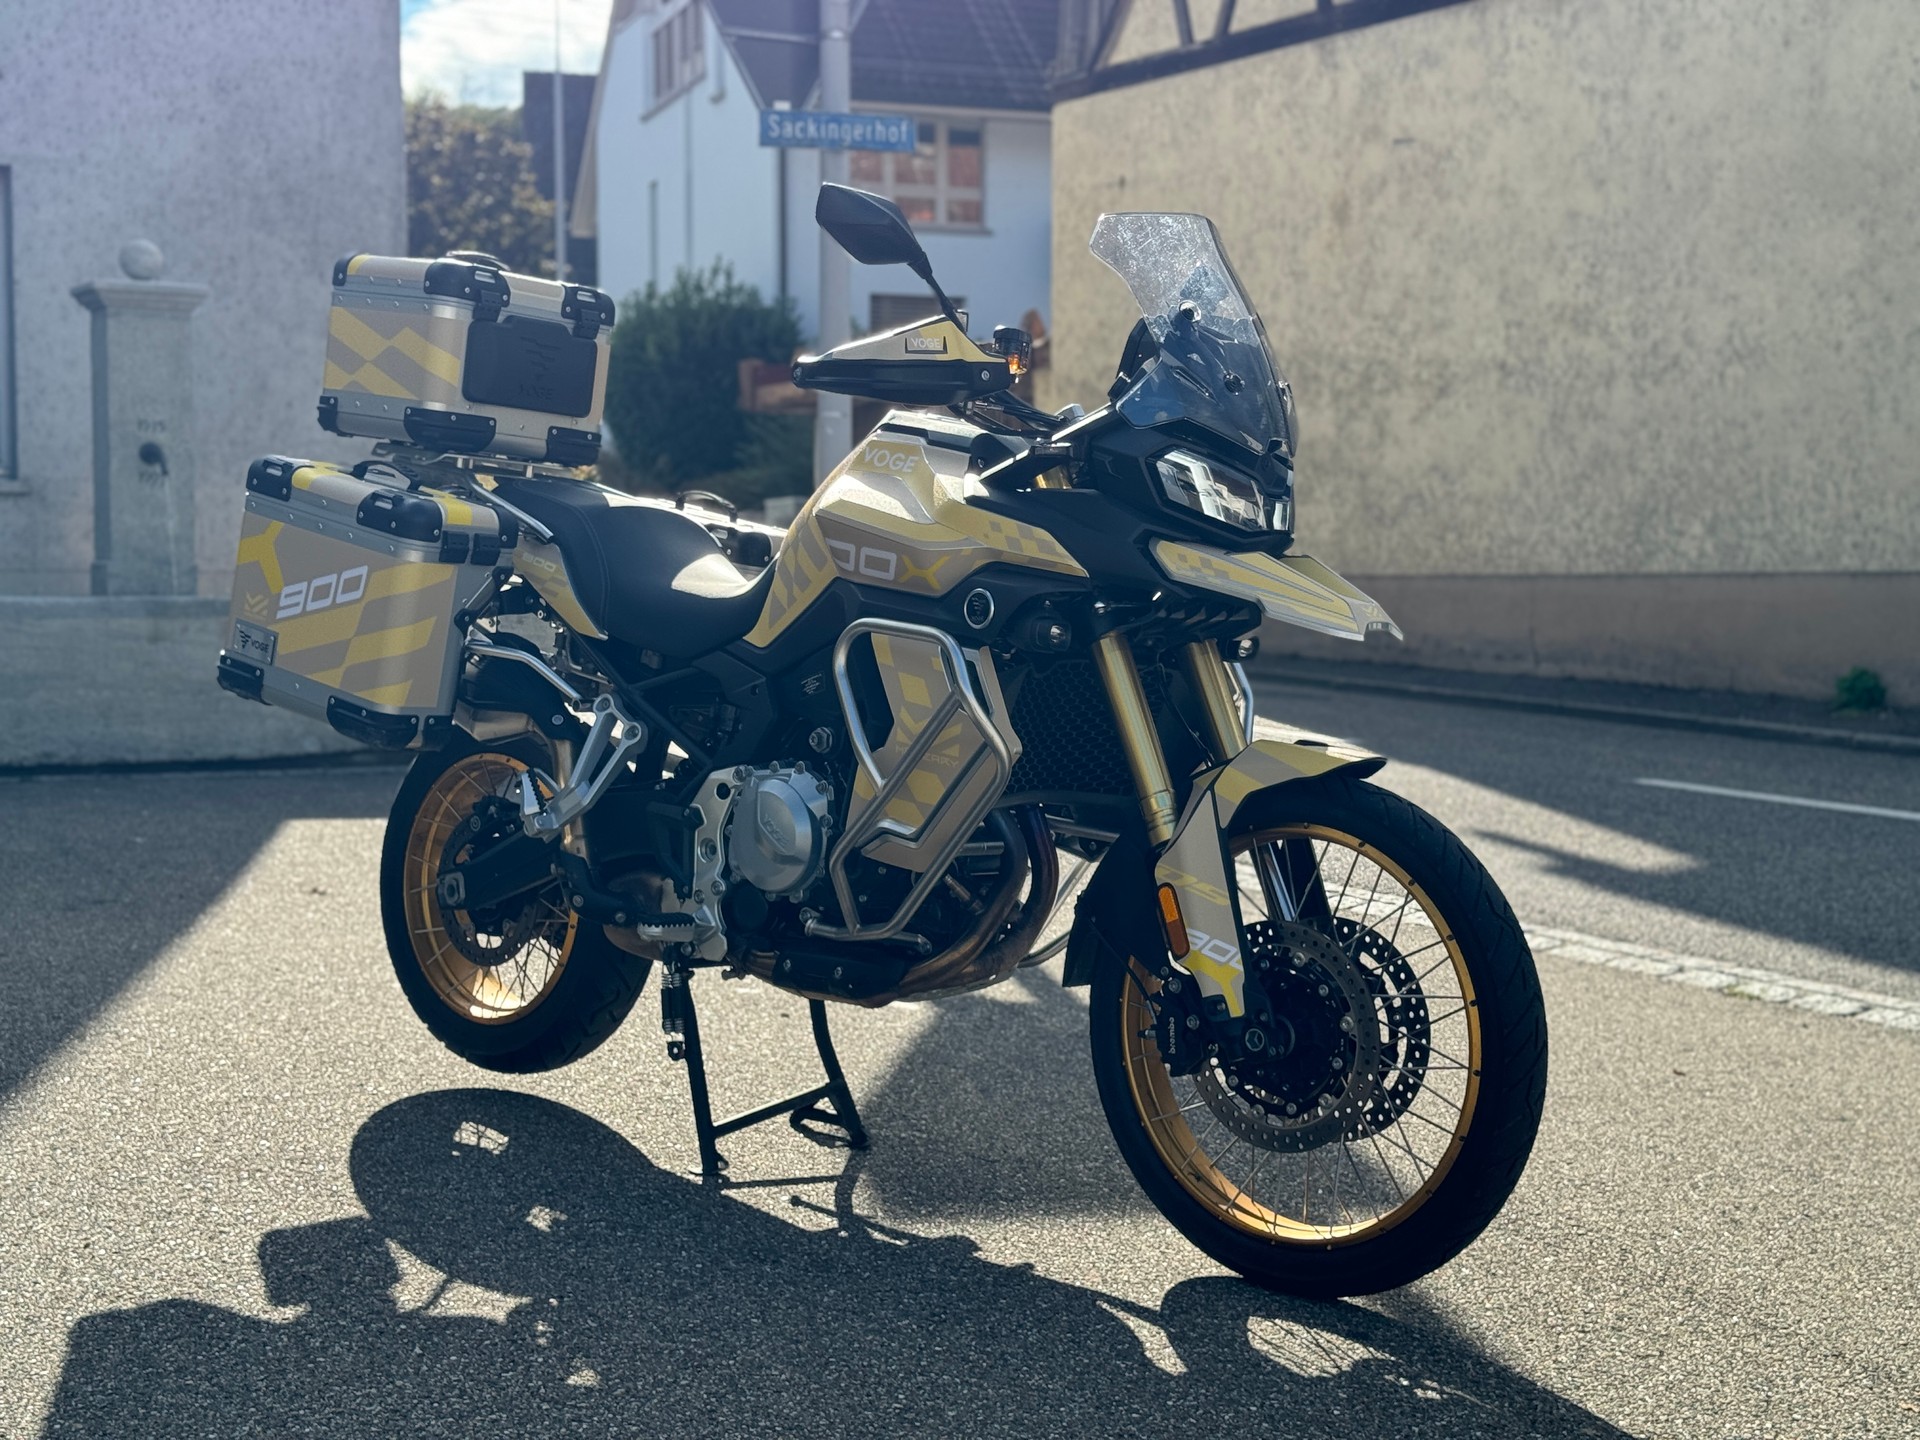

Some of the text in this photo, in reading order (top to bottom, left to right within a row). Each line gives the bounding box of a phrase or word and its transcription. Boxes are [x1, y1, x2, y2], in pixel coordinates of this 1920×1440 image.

[910, 336, 943, 350] VOGE
[862, 446, 920, 473] VOGE
[275, 565, 369, 620] 900
[251, 639, 270, 653] VOGE
[1167, 1016, 1176, 1055] brembo
